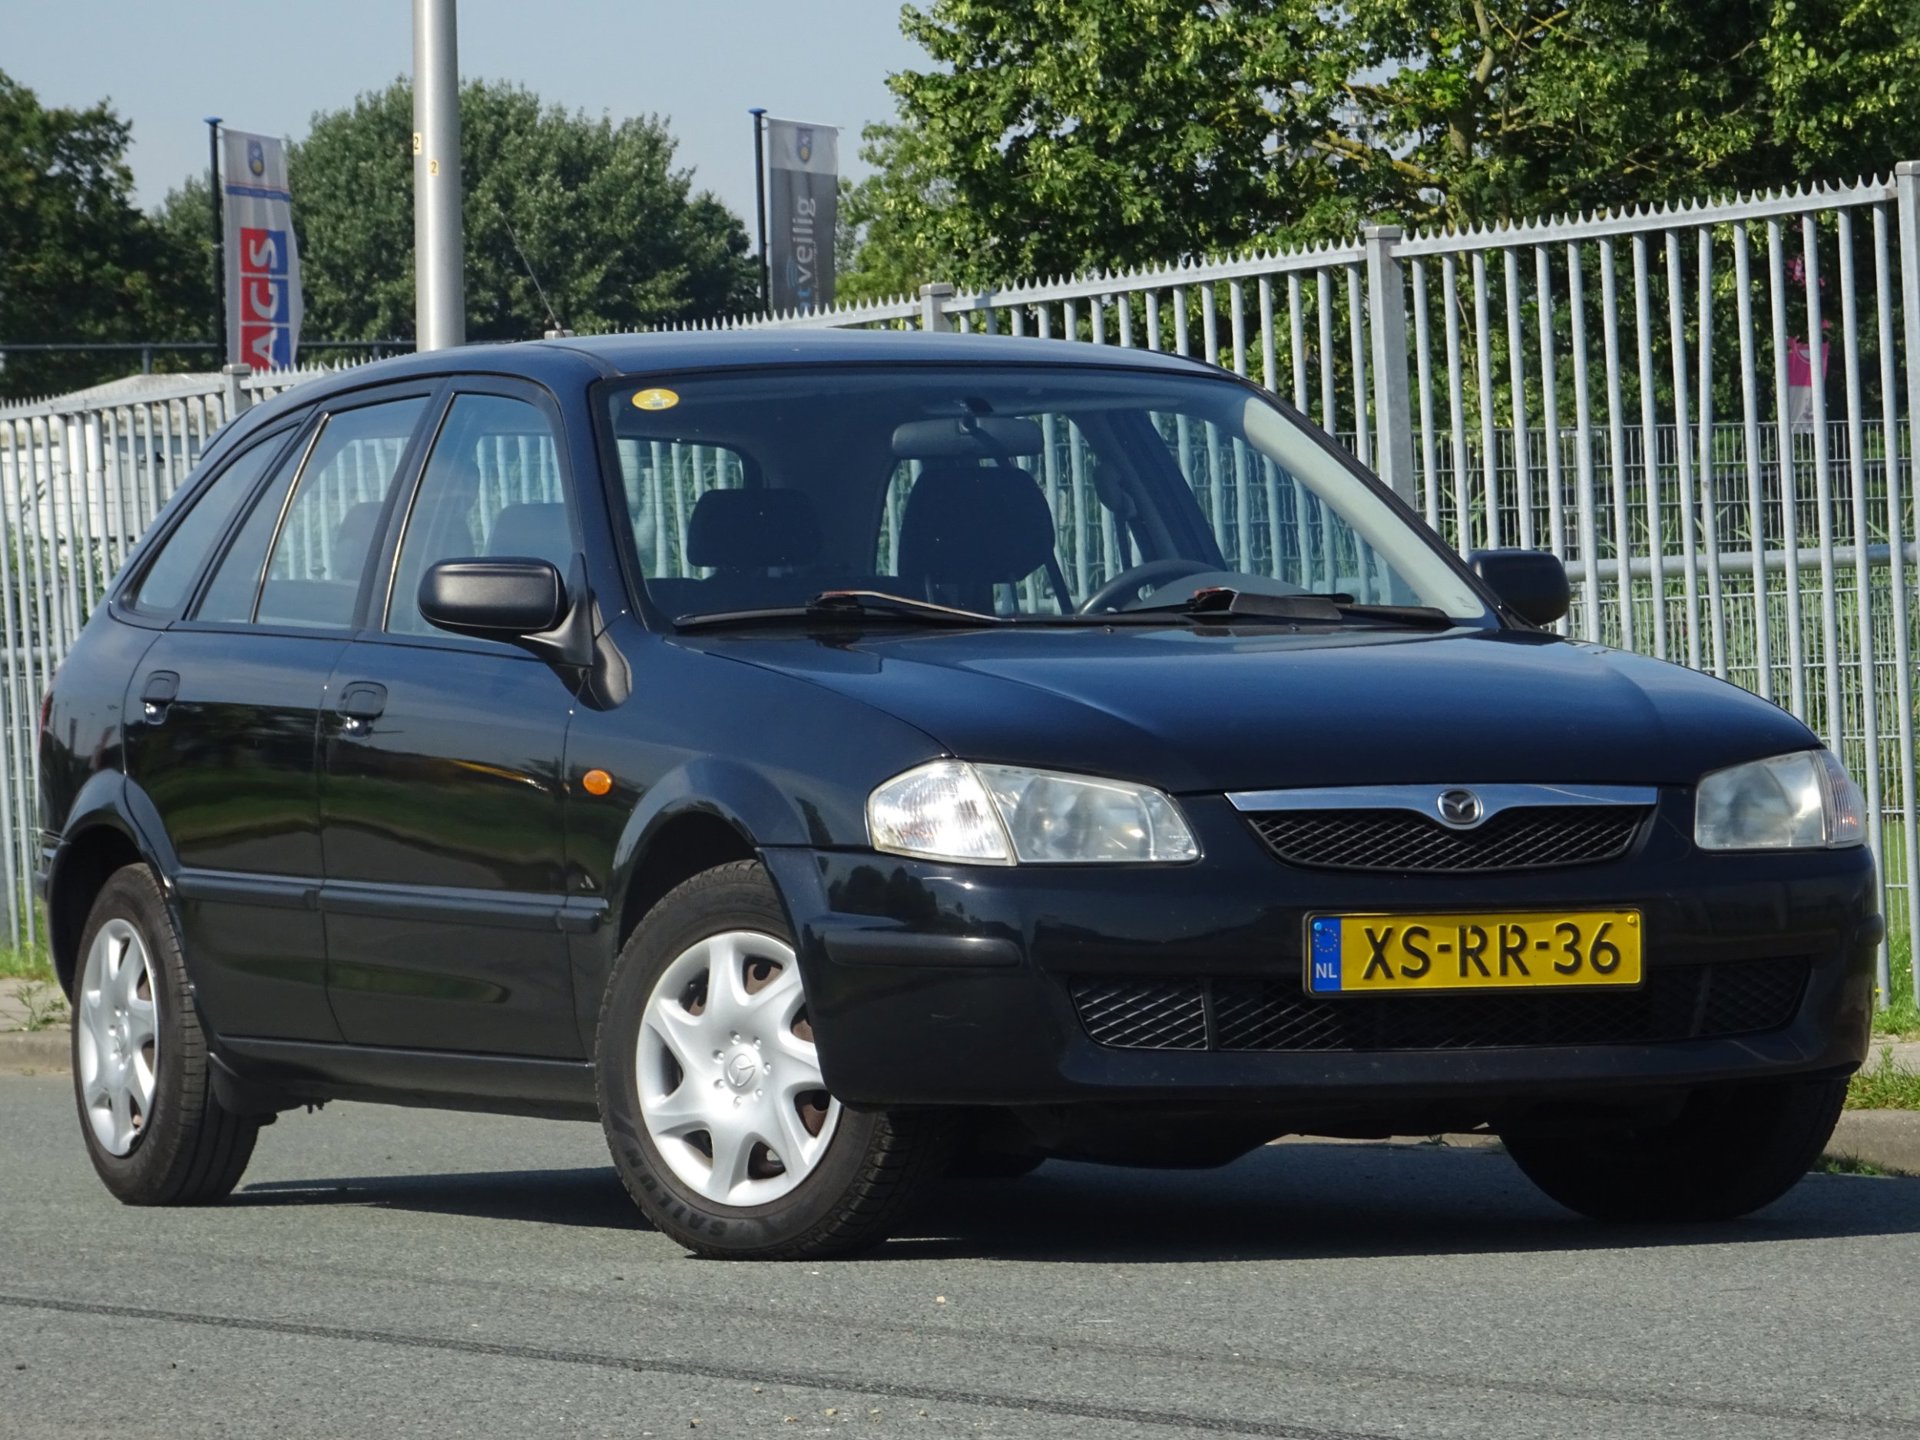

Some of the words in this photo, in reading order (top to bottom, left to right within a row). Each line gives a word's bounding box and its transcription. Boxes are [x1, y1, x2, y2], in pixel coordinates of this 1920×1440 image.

[249, 239, 278, 370] AGS
[1315, 962, 1338, 980] NL
[1361, 921, 1622, 980] XS-RR-36
